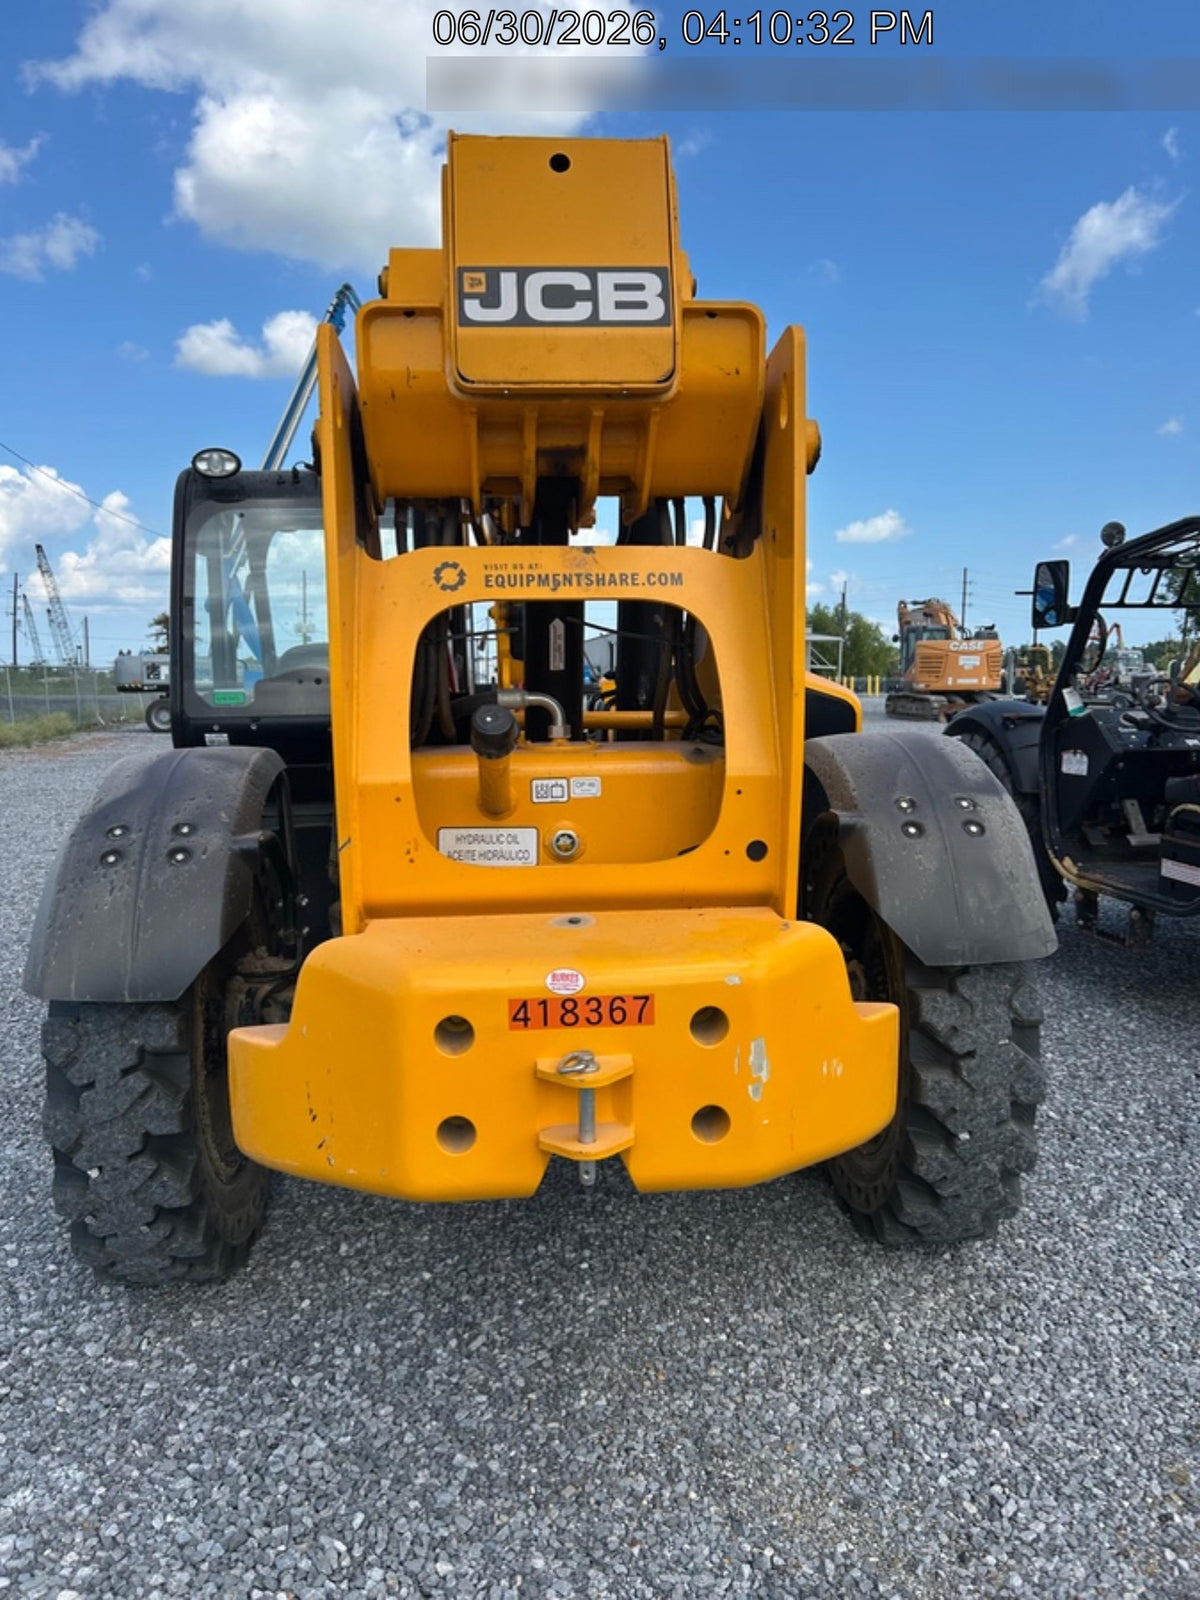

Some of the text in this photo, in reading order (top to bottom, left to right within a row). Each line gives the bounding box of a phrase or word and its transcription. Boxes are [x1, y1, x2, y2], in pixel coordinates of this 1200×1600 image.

[463, 271, 666, 322] JCB
[483, 563, 508, 571] VISIT
[484, 572, 684, 589] EQUIPMENTSHARE.COM
[949, 641, 985, 651] CASE
[455, 833, 520, 845] HYDRAULIC OIL
[511, 996, 650, 1027] 418367
